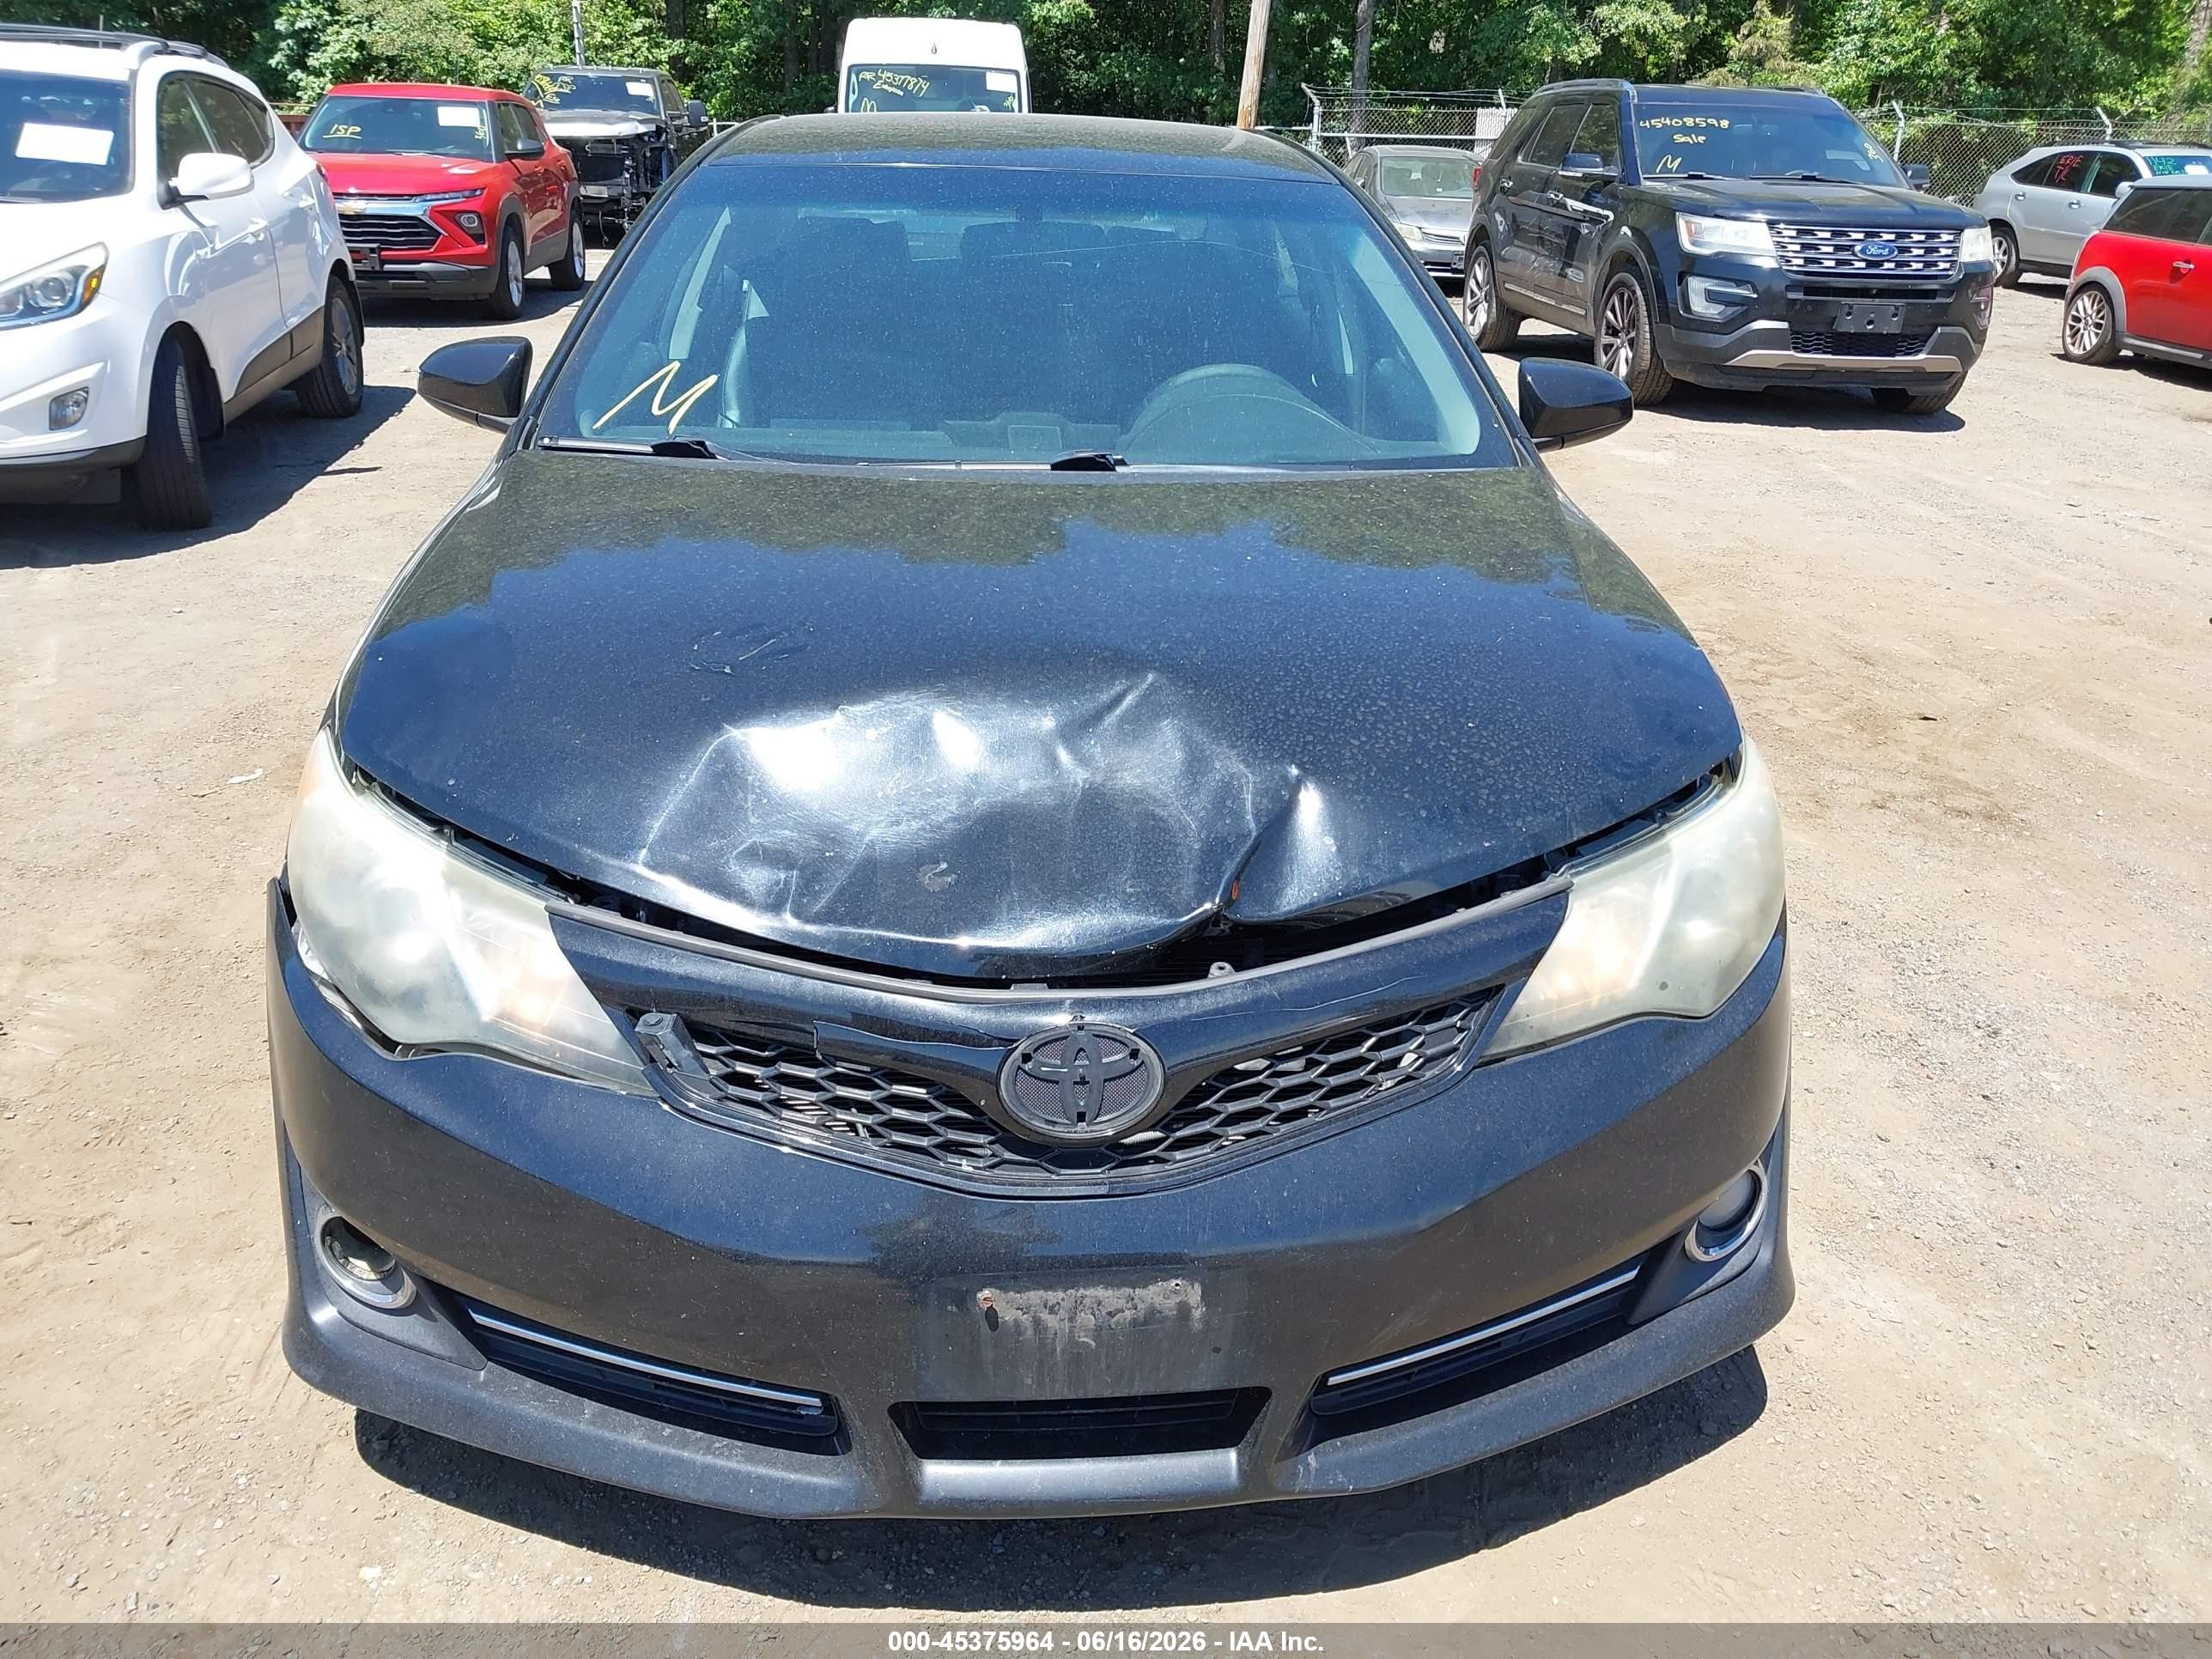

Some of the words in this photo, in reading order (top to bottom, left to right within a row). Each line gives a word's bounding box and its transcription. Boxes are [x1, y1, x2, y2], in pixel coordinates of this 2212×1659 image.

[1639, 117, 1730, 129] 45408598
[1673, 134, 1706, 143] Sale
[1656, 155, 1682, 173] M
[1866, 244, 1889, 255] Ford
[592, 360, 719, 434] M
